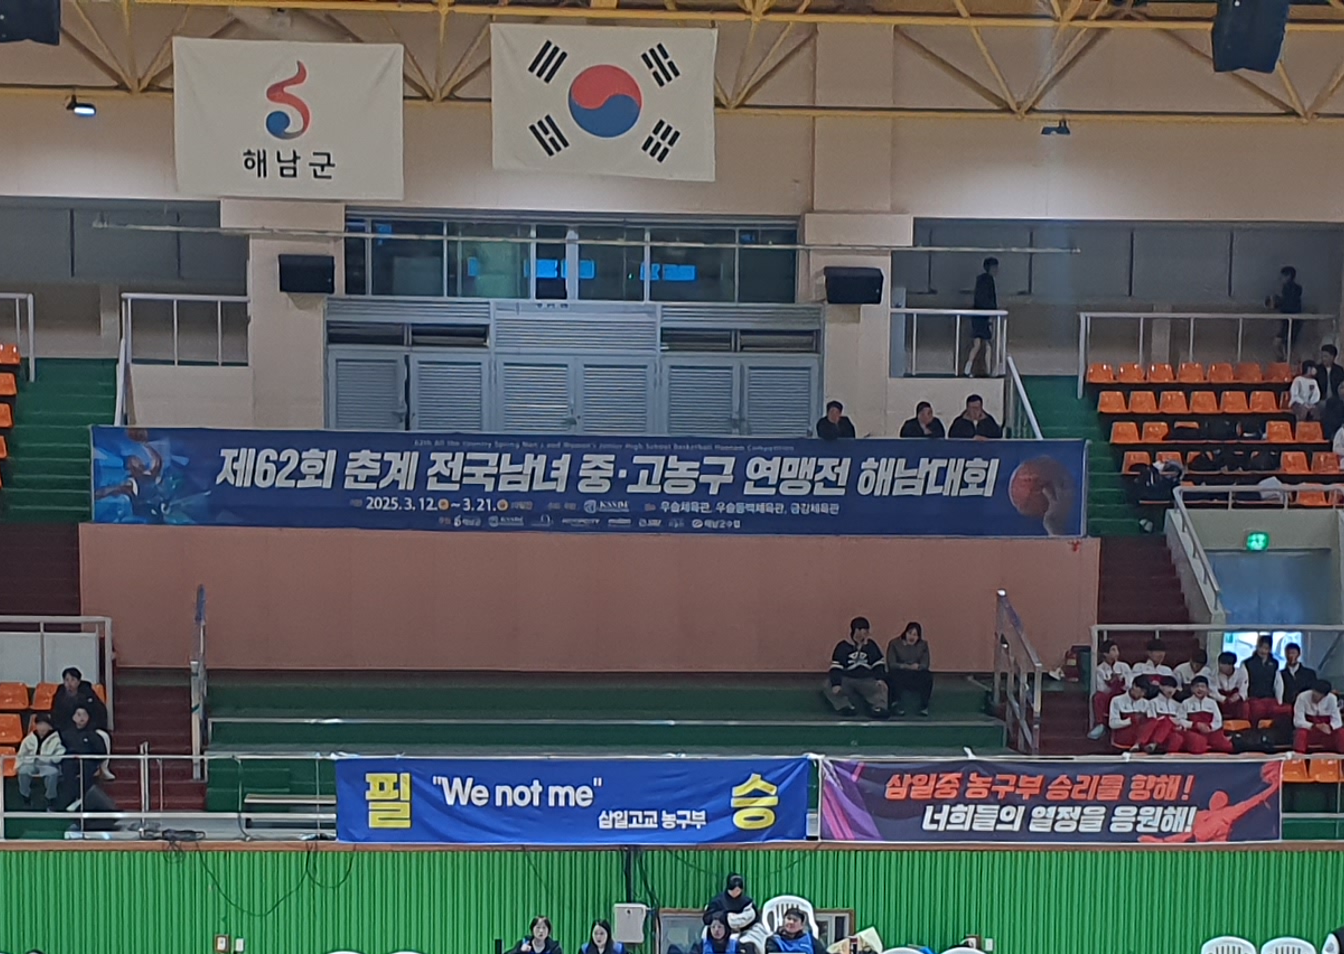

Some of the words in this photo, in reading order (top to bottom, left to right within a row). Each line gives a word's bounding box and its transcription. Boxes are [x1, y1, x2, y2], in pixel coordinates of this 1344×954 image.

[243, 149, 336, 180] 해남군
[216, 448, 336, 488] 제62회
[344, 449, 418, 490] 춘계
[426, 452, 571, 493] 전국남녀
[578, 454, 735, 496] 중·고농구
[744, 457, 852, 497] 연맹전
[858, 457, 1000, 497] 해남대회
[365, 772, 412, 829] 필
[432, 776, 487, 807] "We
[494, 780, 541, 807] not
[547, 776, 603, 807] me"
[730, 773, 779, 830] 승
[884, 773, 963, 801] 삼일중
[966, 773, 1044, 801] 농구부
[1046, 774, 1124, 801] 승리를
[598, 809, 658, 830] 삼일고교
[660, 809, 707, 829] 농구부
[922, 804, 1024, 833] 너희들의
[1027, 804, 1106, 833] 열정을
[1108, 804, 1199, 833] 응원해!
